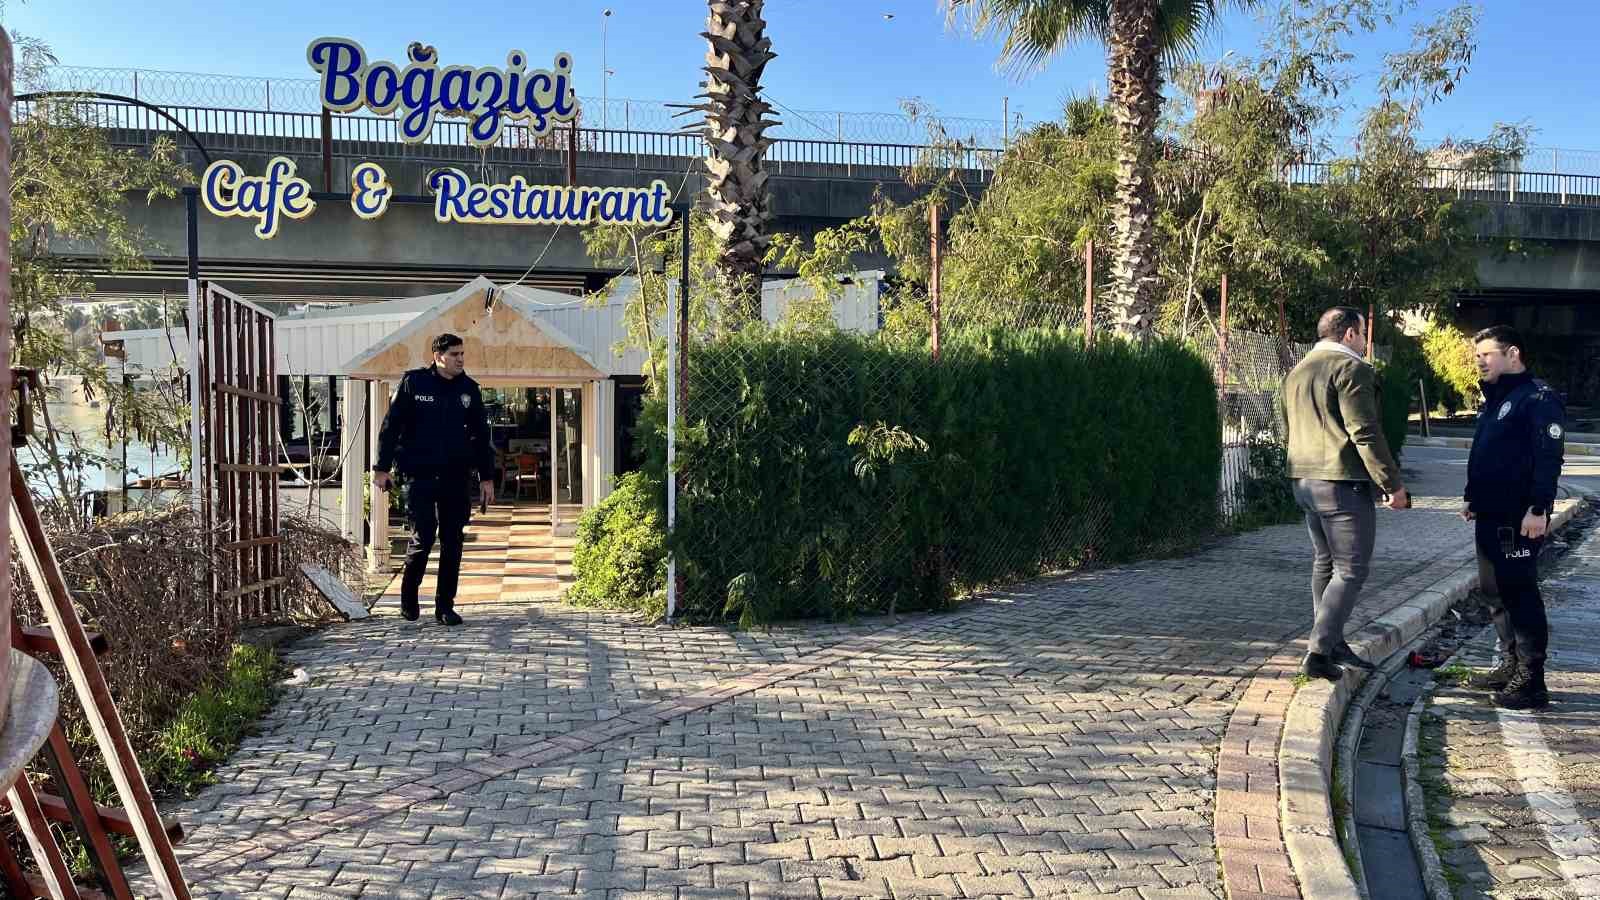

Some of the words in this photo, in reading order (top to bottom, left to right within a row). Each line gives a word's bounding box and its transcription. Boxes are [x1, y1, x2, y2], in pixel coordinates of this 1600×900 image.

[310, 40, 573, 141] Boğaziçi
[204, 161, 311, 235] Cafe
[355, 166, 388, 215] &
[429, 169, 669, 222] Restaurant
